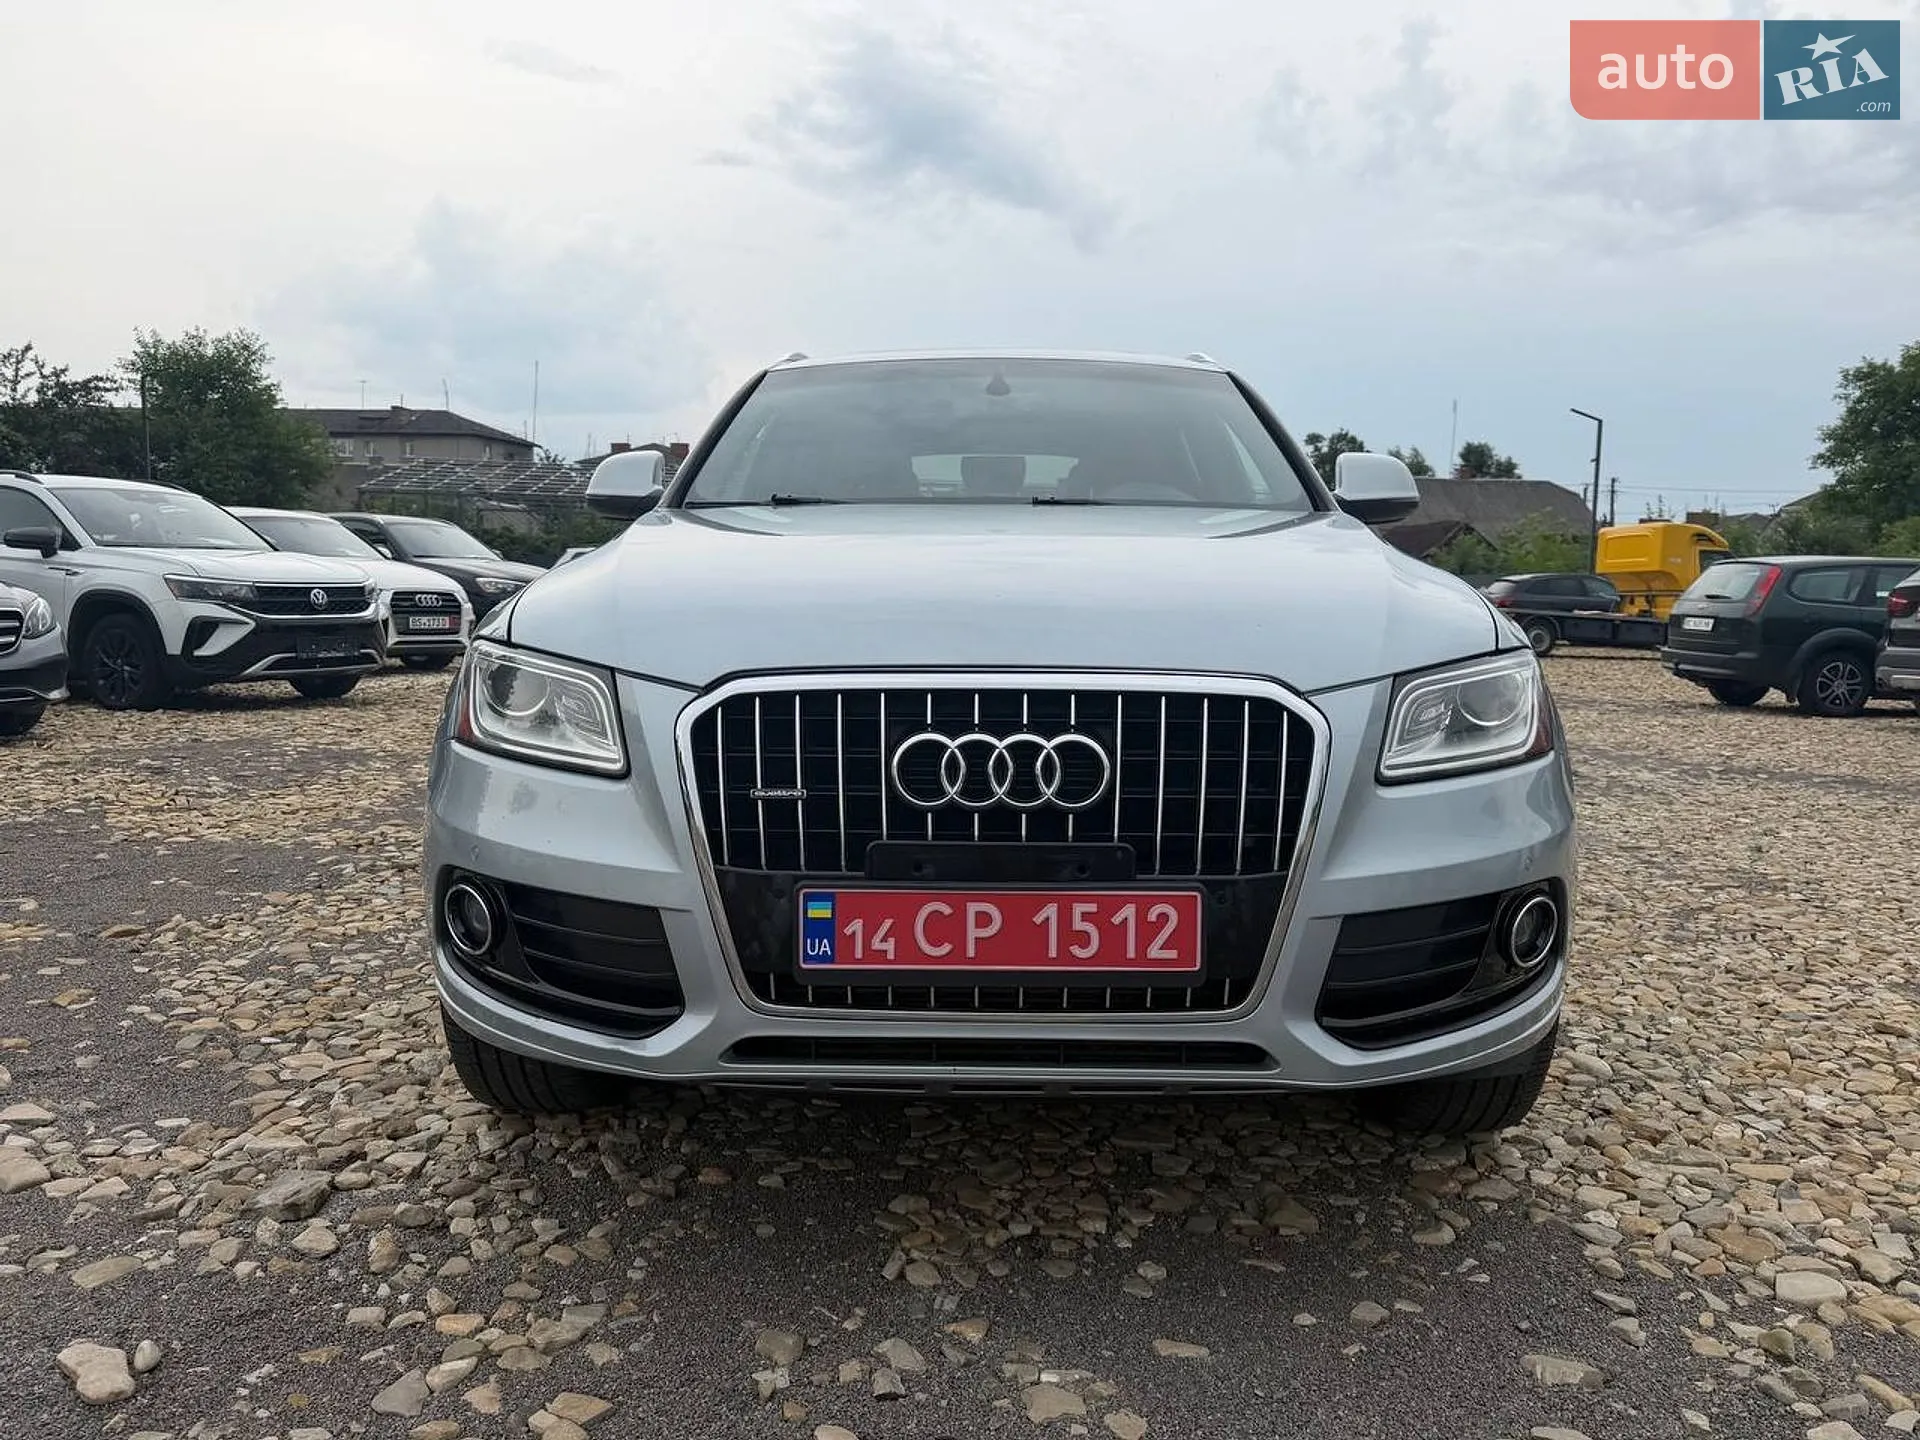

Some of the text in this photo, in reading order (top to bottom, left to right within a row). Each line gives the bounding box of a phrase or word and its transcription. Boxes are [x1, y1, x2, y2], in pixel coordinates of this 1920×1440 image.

[807, 901, 1179, 960] UA 14 CP 1512
